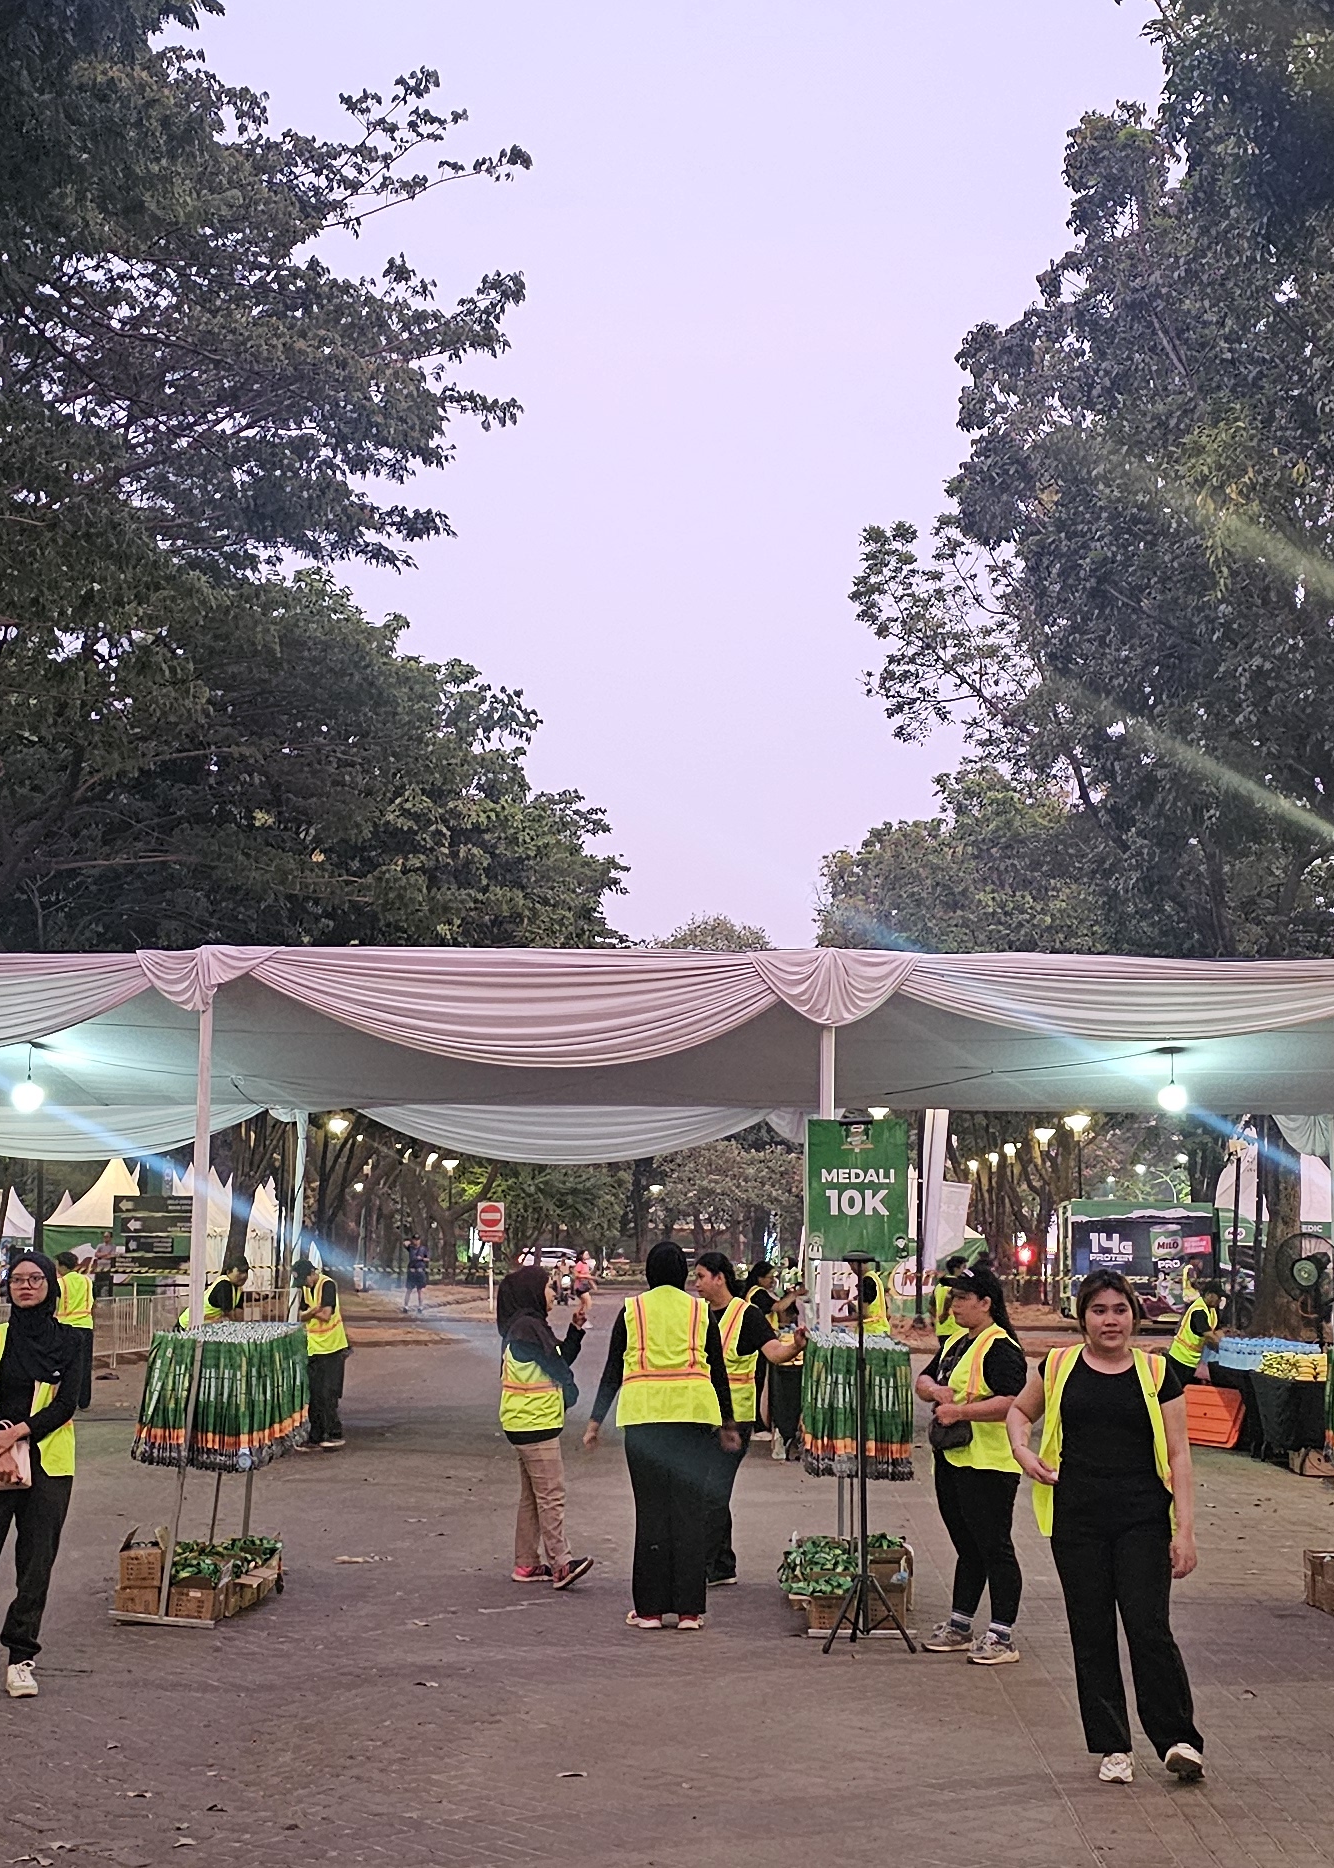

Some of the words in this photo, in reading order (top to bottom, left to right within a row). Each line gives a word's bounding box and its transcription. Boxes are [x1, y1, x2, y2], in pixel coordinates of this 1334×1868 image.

[821, 1169, 895, 1183] MEDALI
[826, 1189, 890, 1216] 10K
[1156, 1241, 1180, 1250] MILO
[1090, 1254, 1133, 1262] PROTEIN
[1157, 1260, 1180, 1269] PRO
